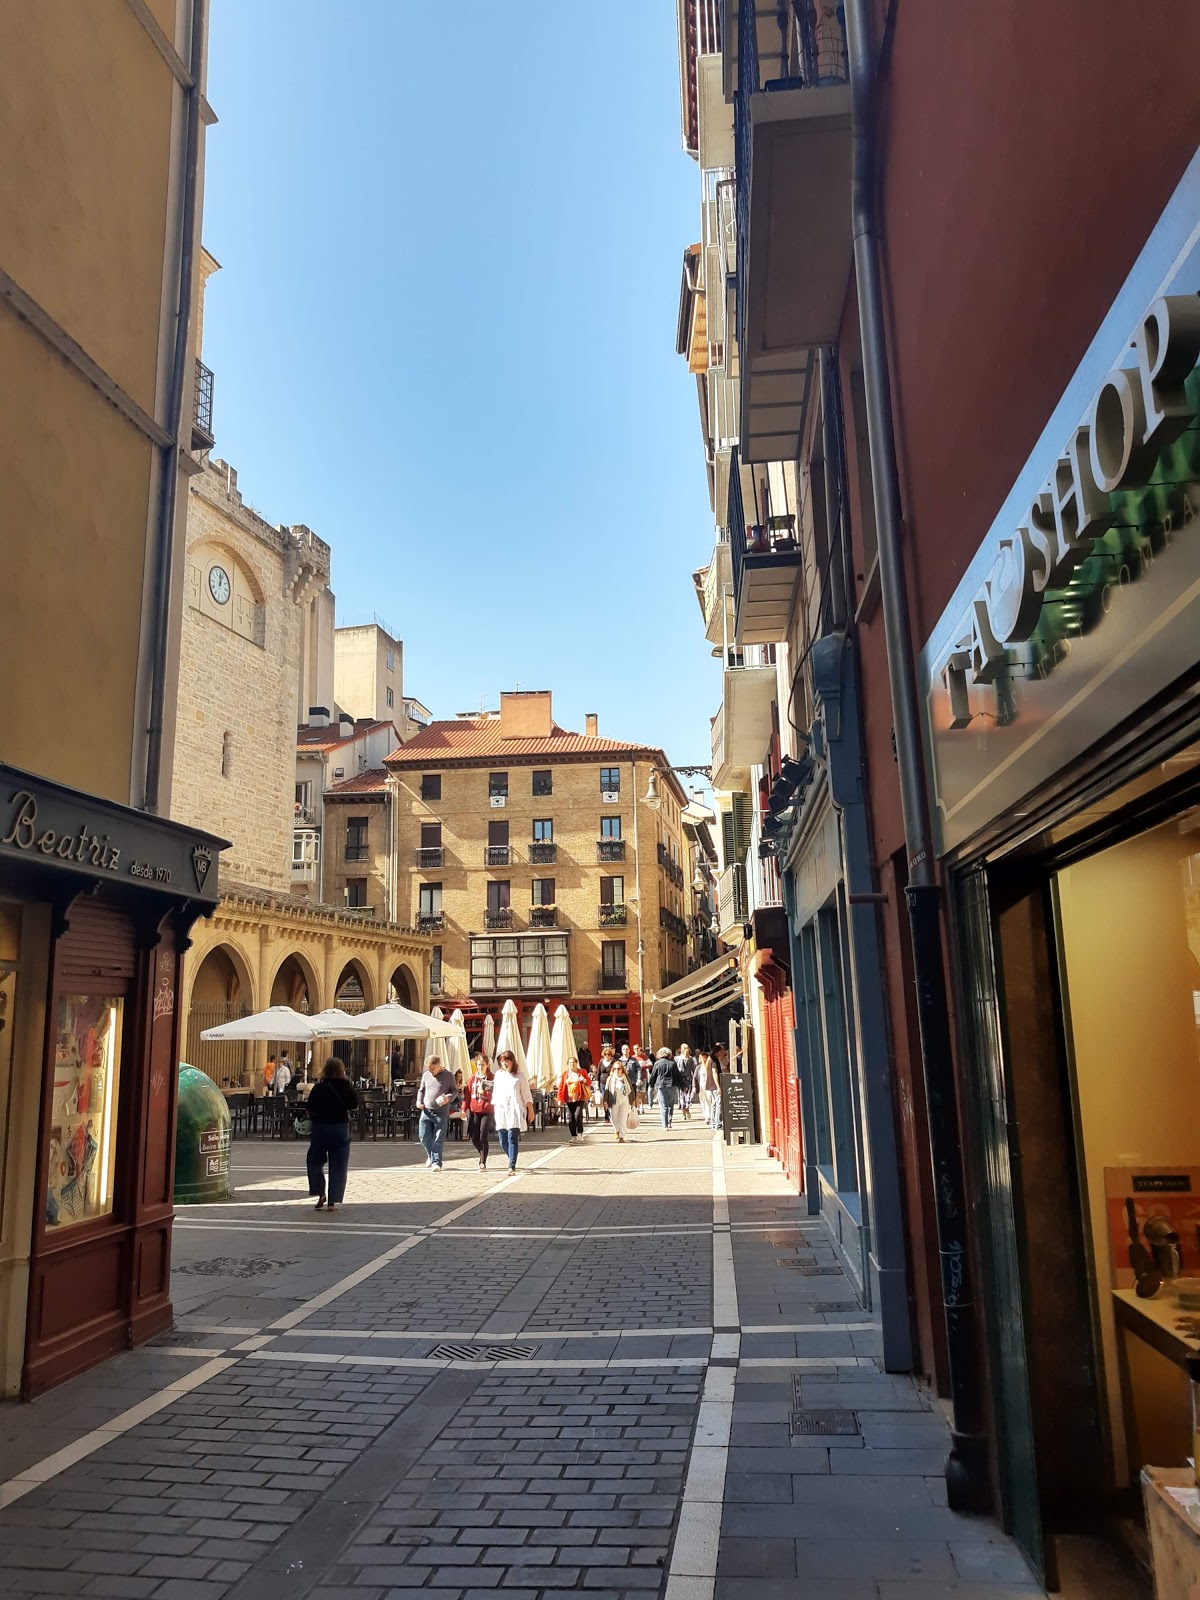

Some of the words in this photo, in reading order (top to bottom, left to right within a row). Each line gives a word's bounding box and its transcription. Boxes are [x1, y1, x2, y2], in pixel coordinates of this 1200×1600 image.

[2, 790, 121, 870] Beatriz
[131, 861, 153, 879] desde
[155, 867, 172, 883] 1970
